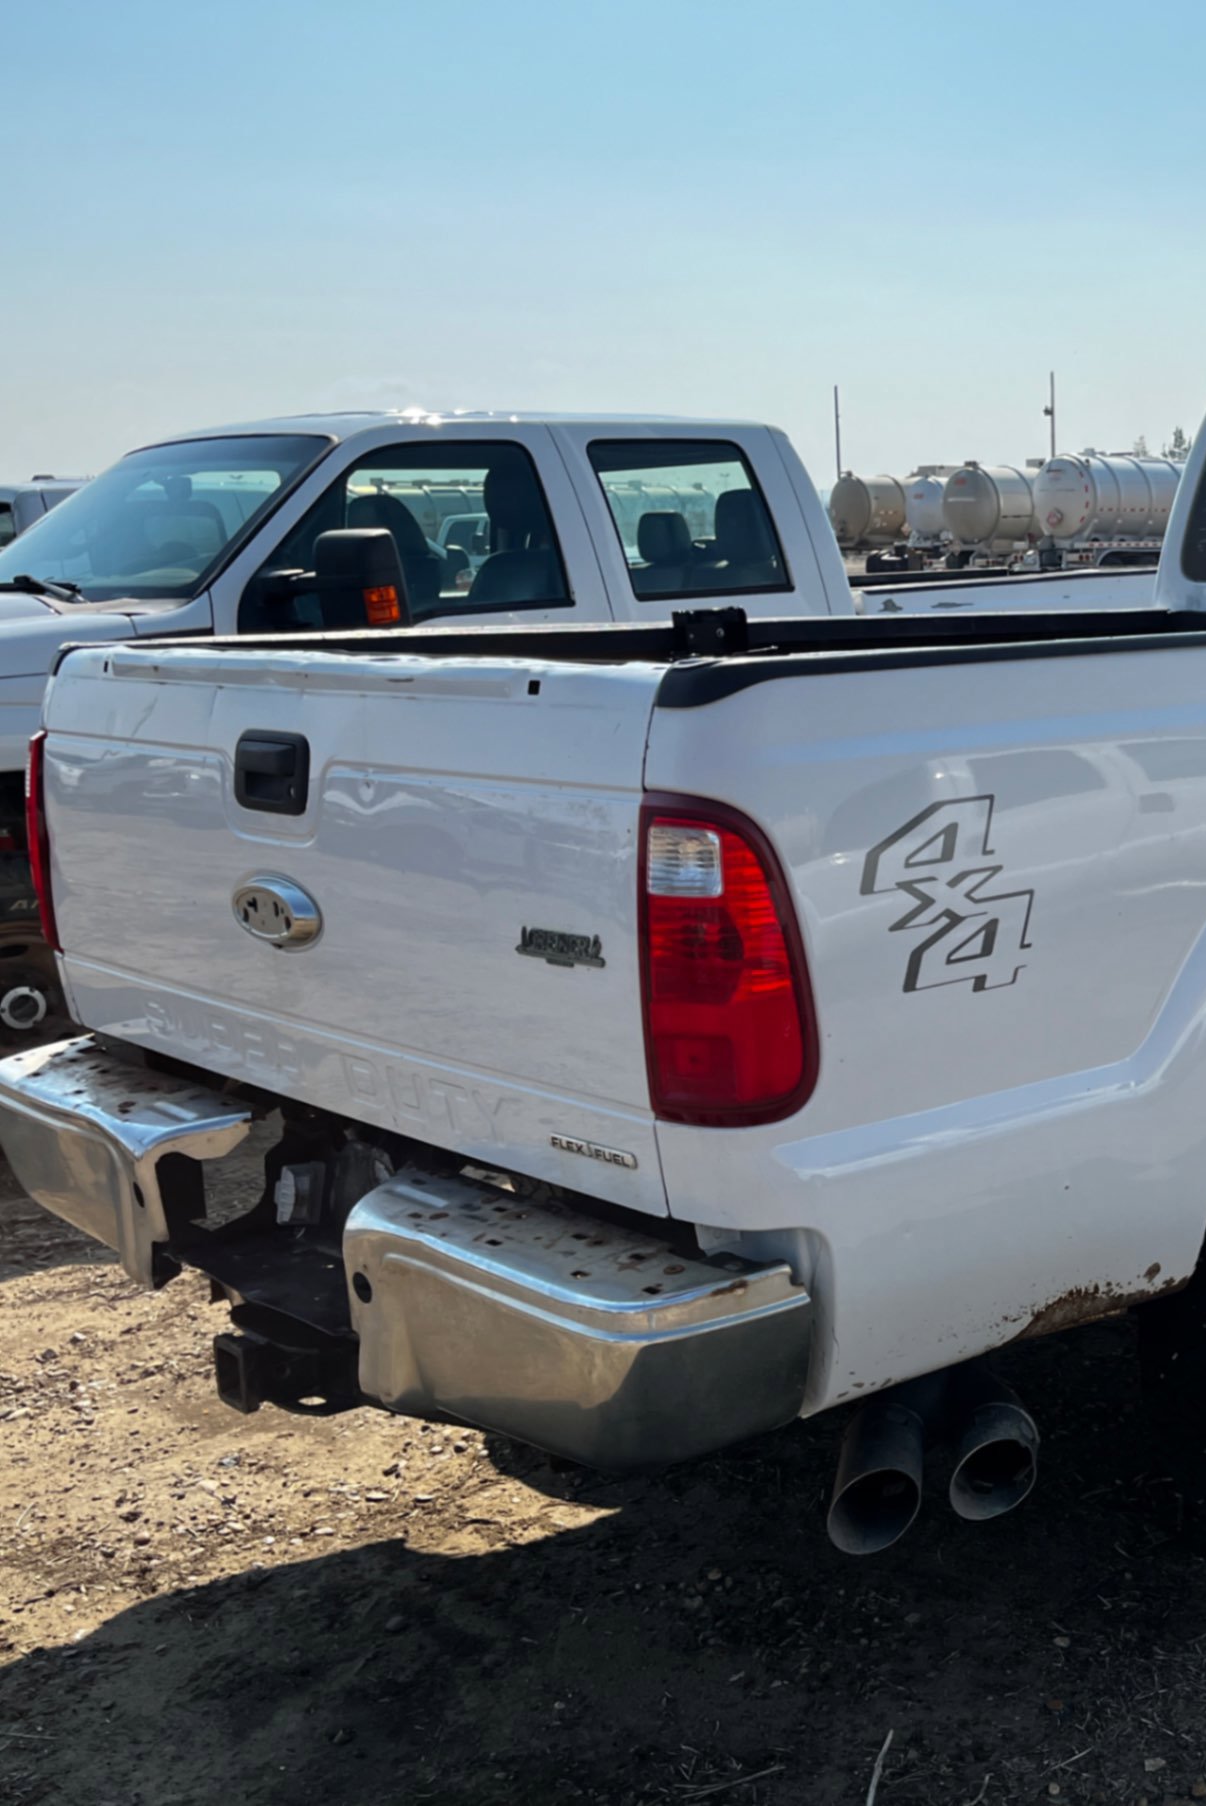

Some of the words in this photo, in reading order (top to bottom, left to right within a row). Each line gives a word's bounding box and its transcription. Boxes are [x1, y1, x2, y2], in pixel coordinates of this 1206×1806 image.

[339, 1053, 522, 1146] DUTY
[550, 1135, 586, 1156] FLEX
[593, 1148, 631, 1168] FUEL
